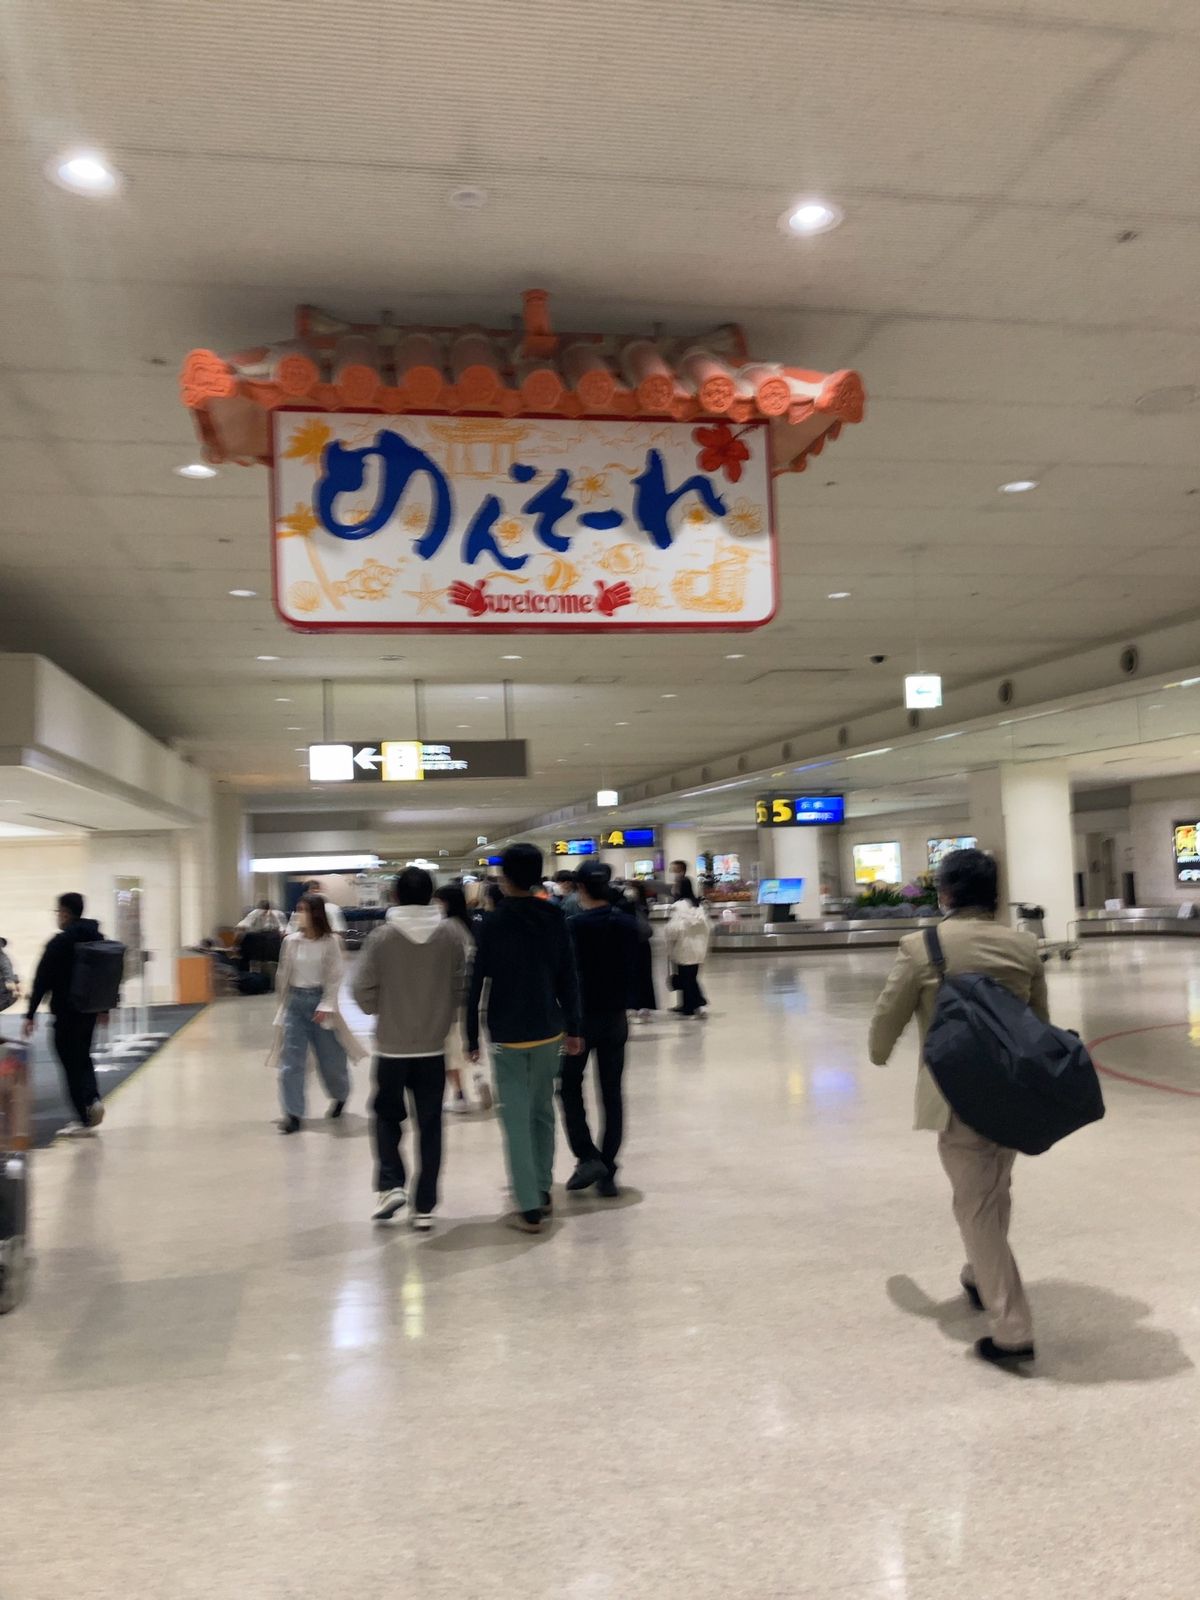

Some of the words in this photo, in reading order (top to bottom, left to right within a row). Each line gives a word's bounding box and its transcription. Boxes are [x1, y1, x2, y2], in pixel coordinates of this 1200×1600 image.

[316, 430, 726, 569] めんそーれ
[485, 590, 593, 613] welcome
[772, 799, 792, 823] 5
